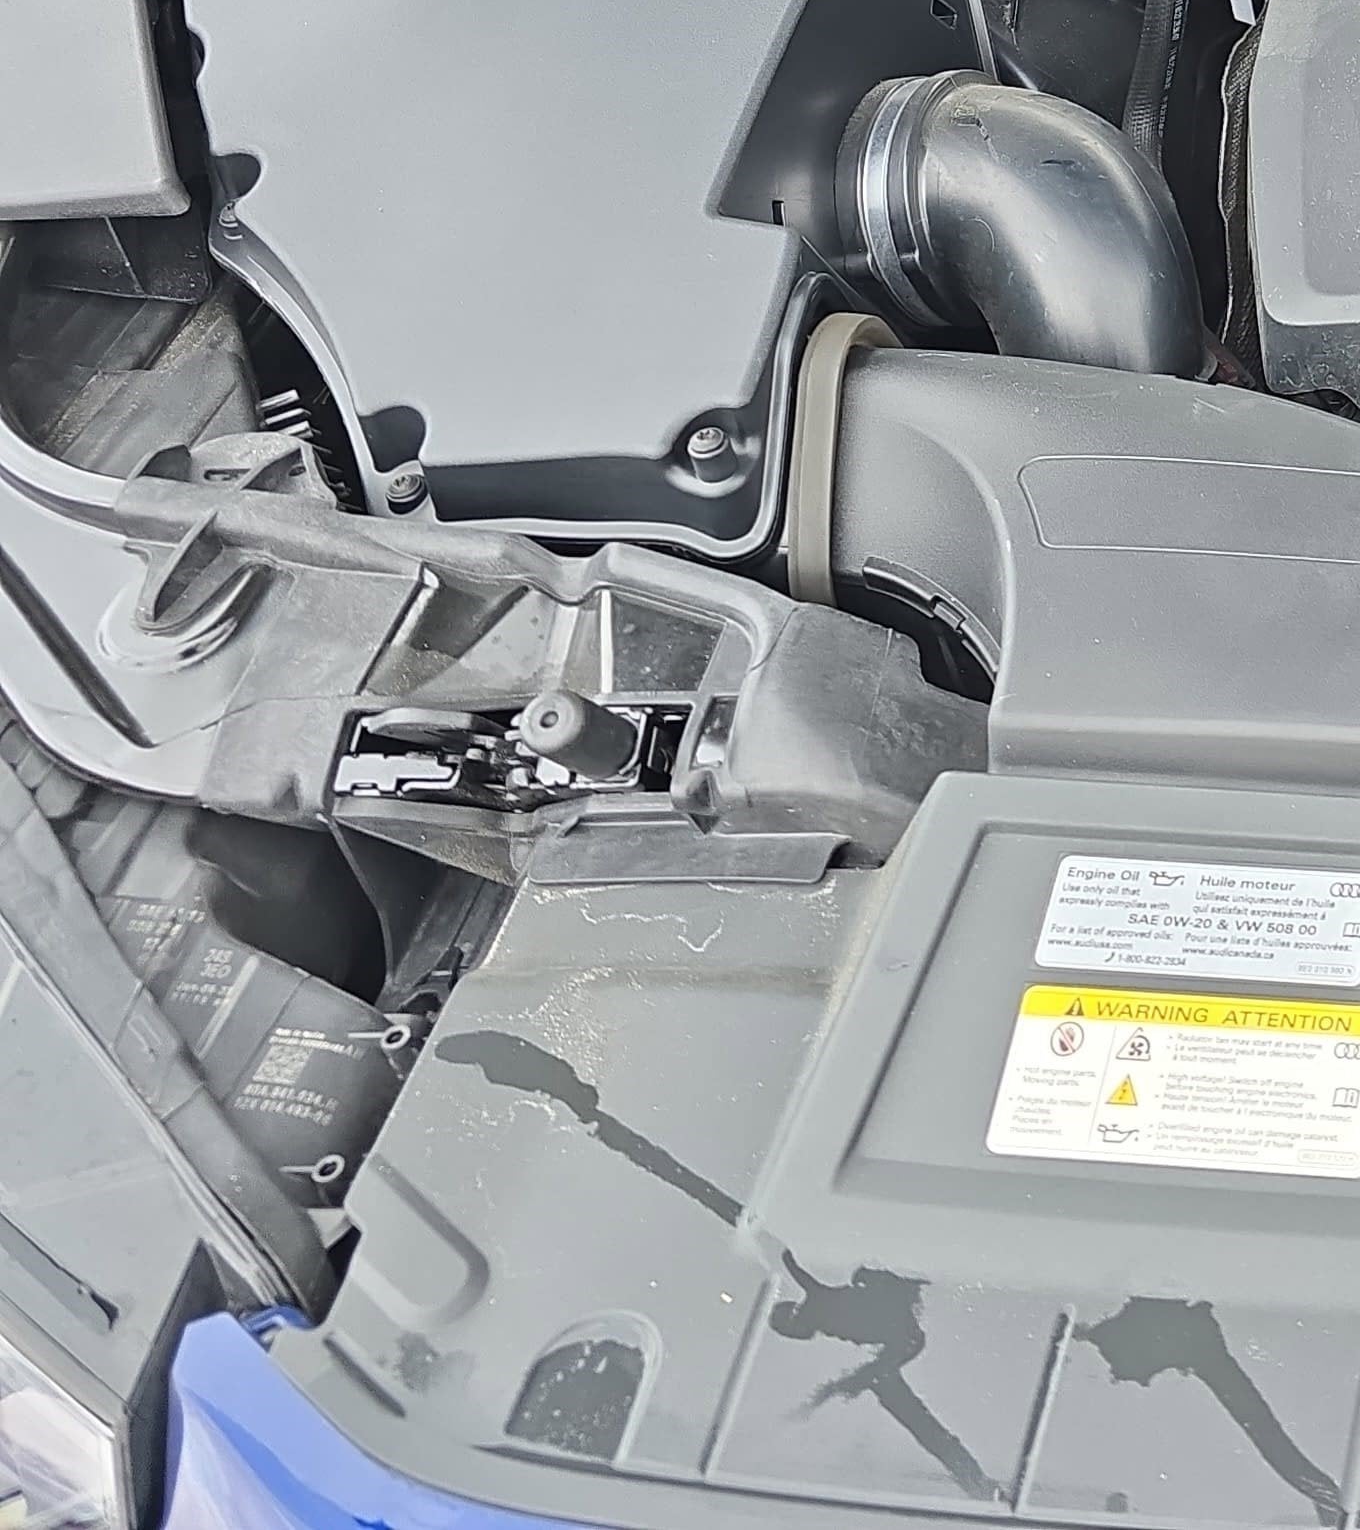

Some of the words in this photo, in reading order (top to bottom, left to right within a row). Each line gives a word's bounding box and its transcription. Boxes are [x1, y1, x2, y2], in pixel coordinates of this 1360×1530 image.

[1067, 867, 1116, 881] Engine
[1120, 870, 1140, 881] Oil
[1062, 882, 1081, 892] Use
[1083, 884, 1103, 895] only
[1106, 885, 1119, 894] oil
[1121, 886, 1141, 896] that
[1200, 875, 1237, 888] Huile
[1240, 878, 1296, 891] moteur
[1150, 901, 1170, 910] with
[1291, 897, 1304, 907] de
[1193, 904, 1209, 915] qui
[1050, 923, 1067, 934] For
[1128, 913, 1160, 926] SAE
[1163, 916, 1212, 929] 0W-20
[1216, 919, 1229, 931] &
[1235, 920, 1263, 932] VW
[1266, 922, 1294, 935] 508
[1298, 925, 1318, 936] 00
[1184, 932, 1208, 943] Pour
[1209, 935, 1228, 945] une
[1096, 1001, 1208, 1023] WARNING
[1222, 1008, 1353, 1032] ATTENTION
